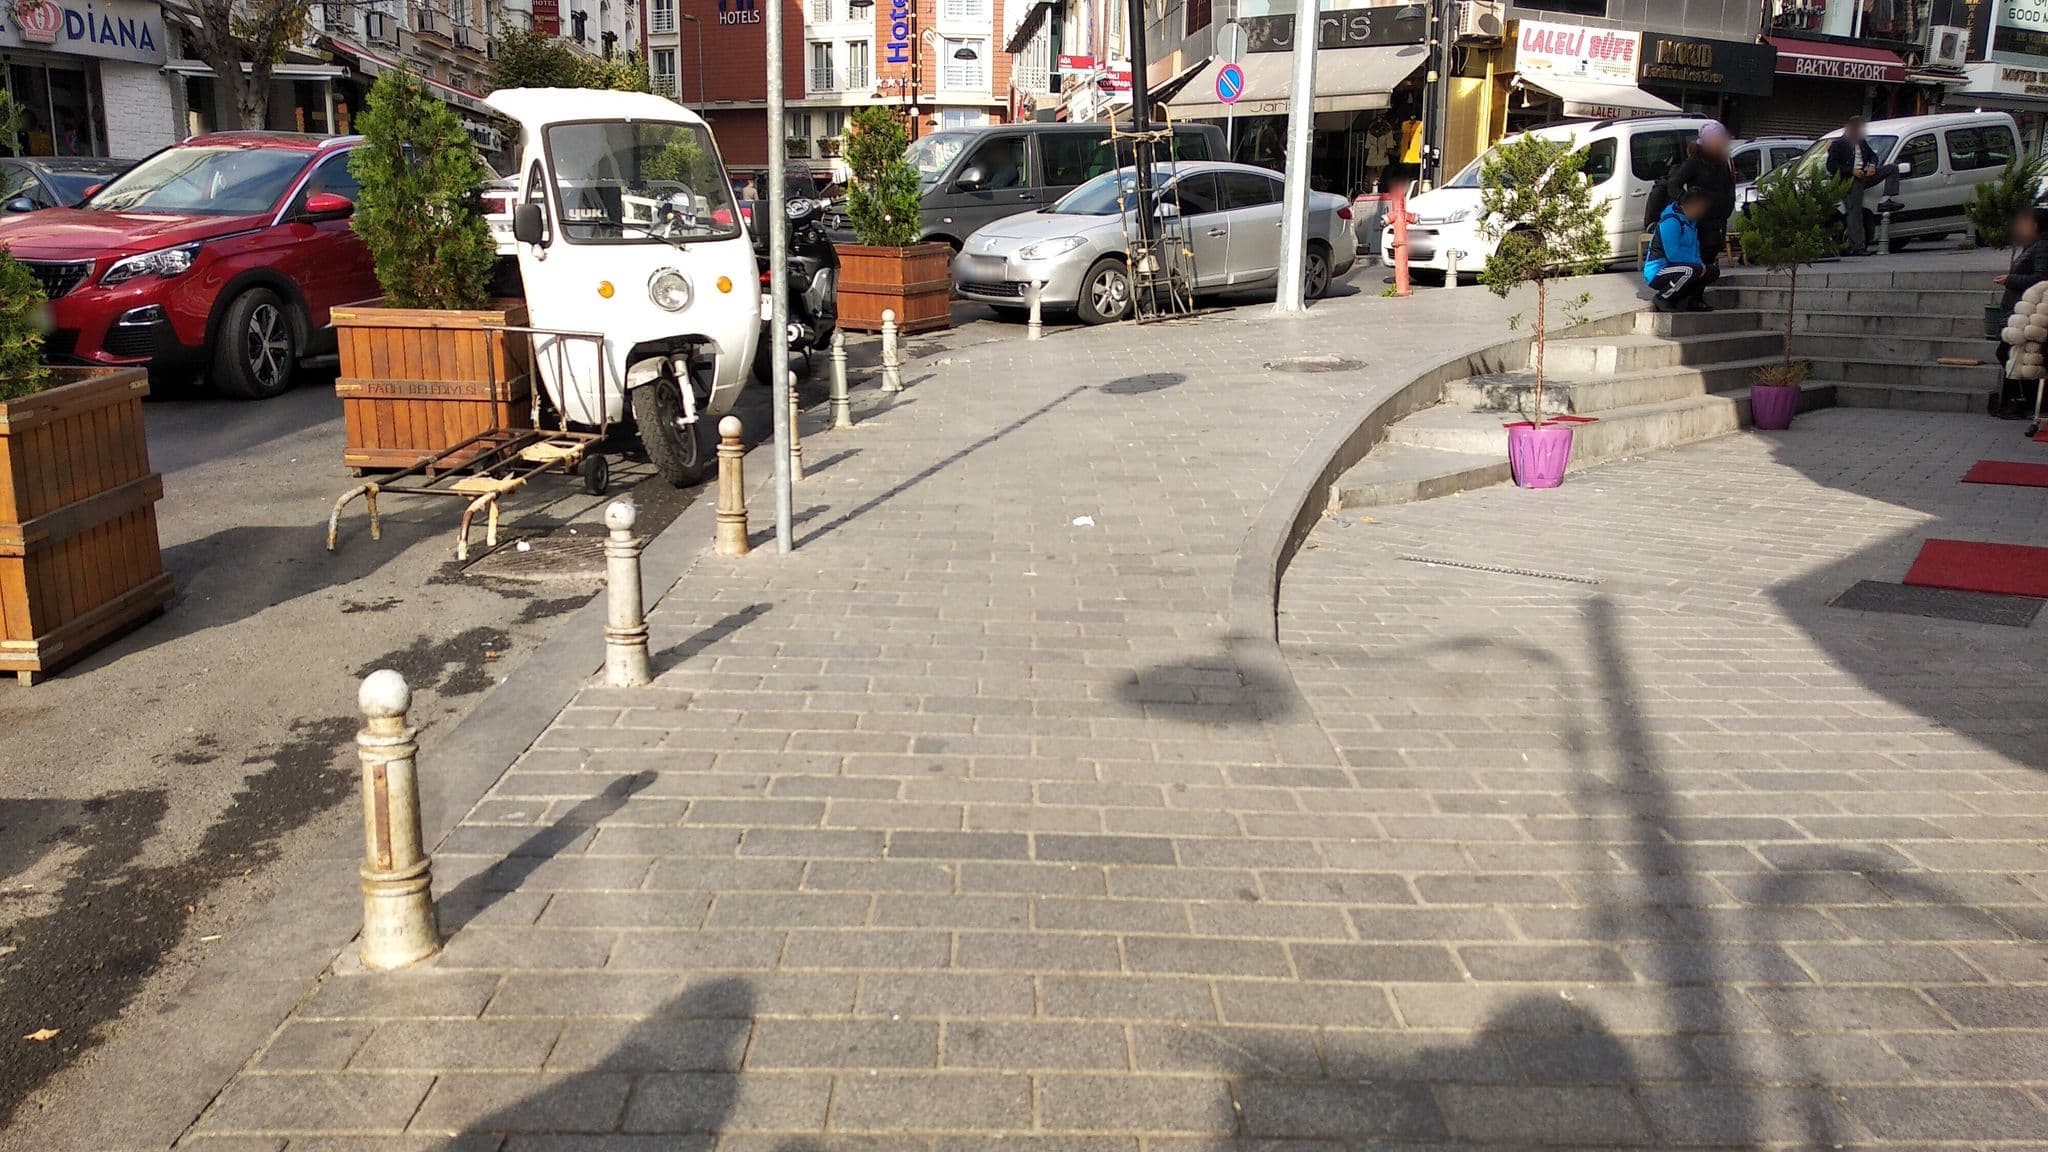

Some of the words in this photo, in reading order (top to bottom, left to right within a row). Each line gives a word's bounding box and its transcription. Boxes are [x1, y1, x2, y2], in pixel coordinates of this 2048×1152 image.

[719, 9, 760, 25] HOTELS
[2008, 8, 2041, 22] GOOD
[1523, 28, 1586, 57] LALELİ
[1589, 32, 1635, 62] BÜFE
[1843, 62, 1887, 80] EXPORT
